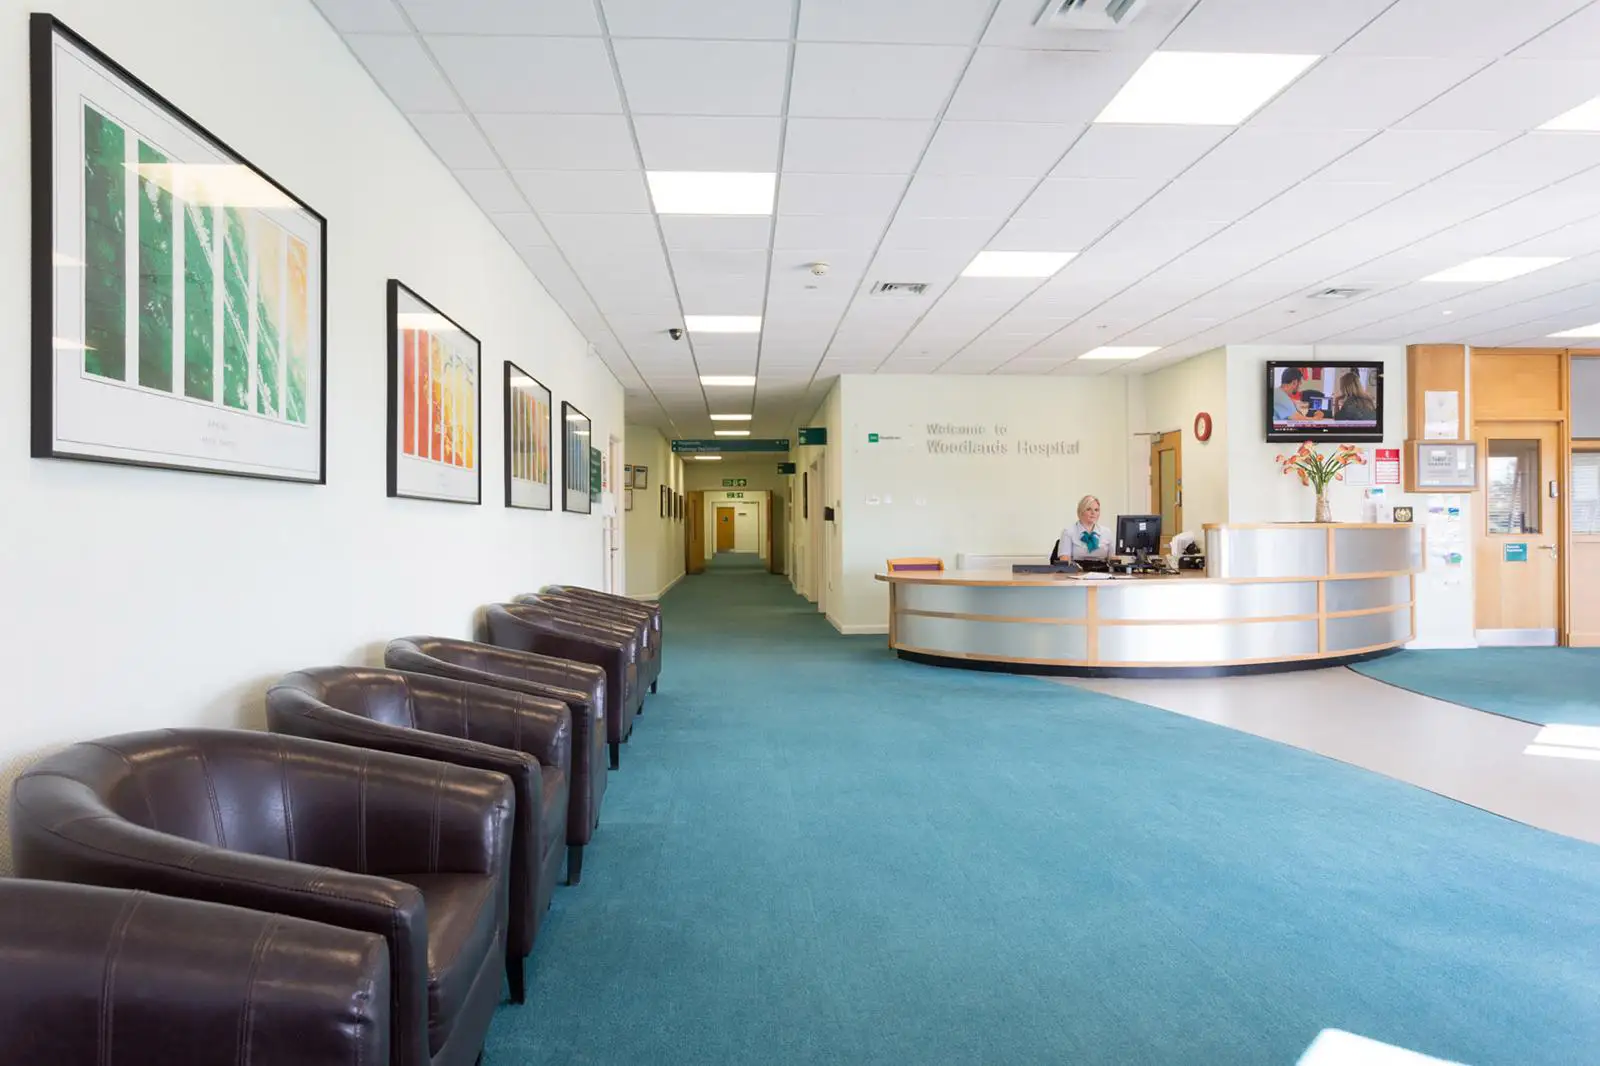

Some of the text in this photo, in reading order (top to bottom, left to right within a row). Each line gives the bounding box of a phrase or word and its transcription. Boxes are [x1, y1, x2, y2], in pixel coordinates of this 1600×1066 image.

[926, 423, 1008, 435] Welcome to
[926, 440, 1080, 457] Woodlands Hospital
